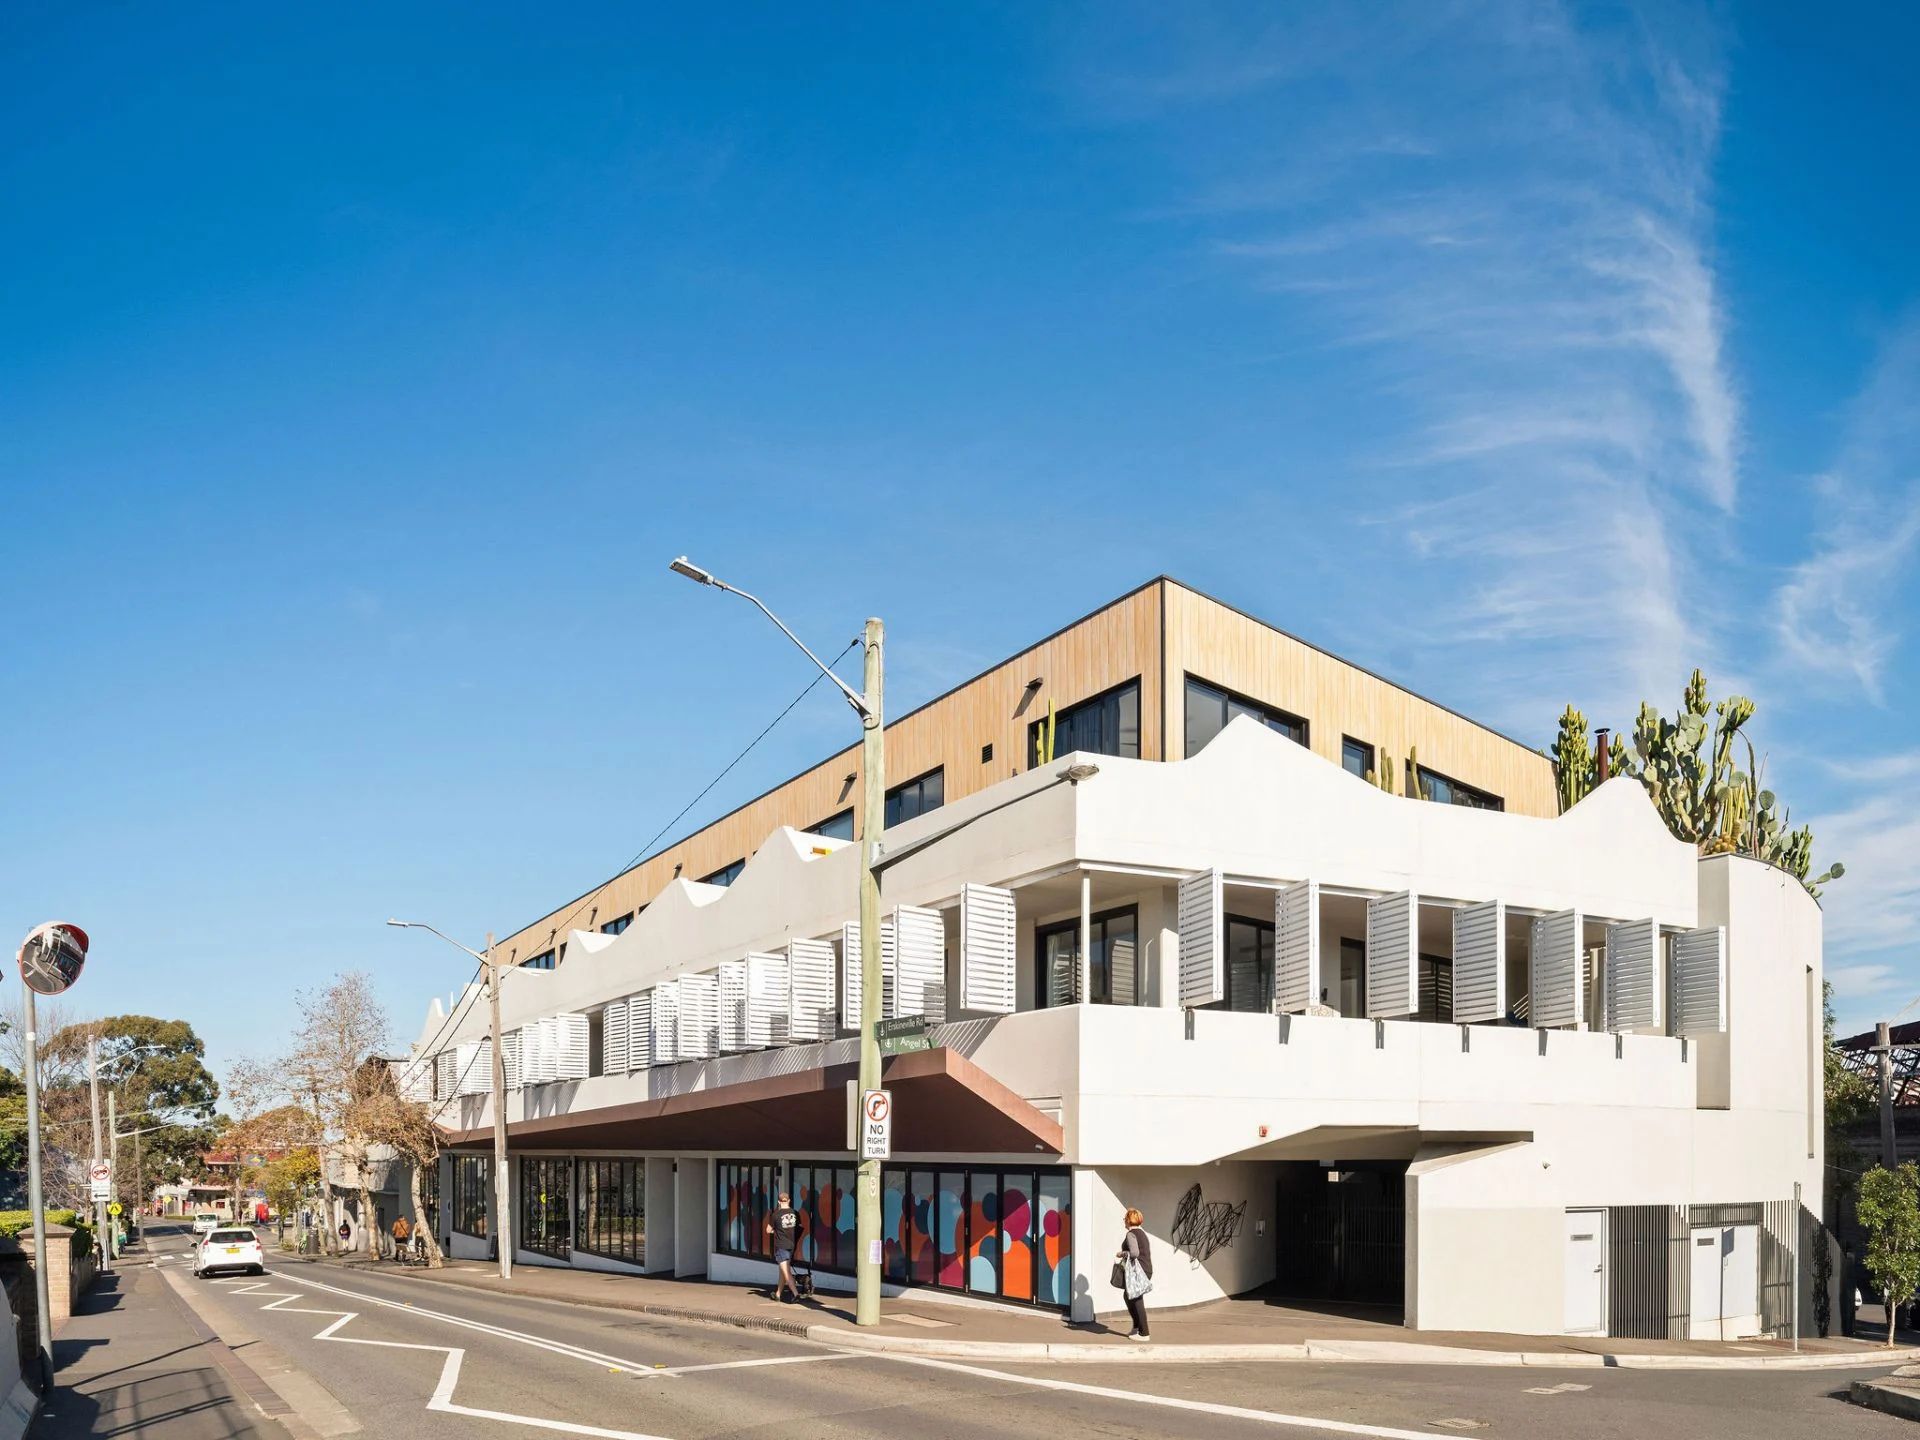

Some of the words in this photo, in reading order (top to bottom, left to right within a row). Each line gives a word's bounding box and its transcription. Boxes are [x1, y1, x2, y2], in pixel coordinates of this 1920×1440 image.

[916, 1017, 924, 1026] Rd
[900, 1037, 920, 1049] Angel
[922, 1039, 930, 1049] St
[870, 1125, 884, 1135] NO
[867, 1137, 886, 1145] RIGHT
[868, 1147, 886, 1155] TURN
